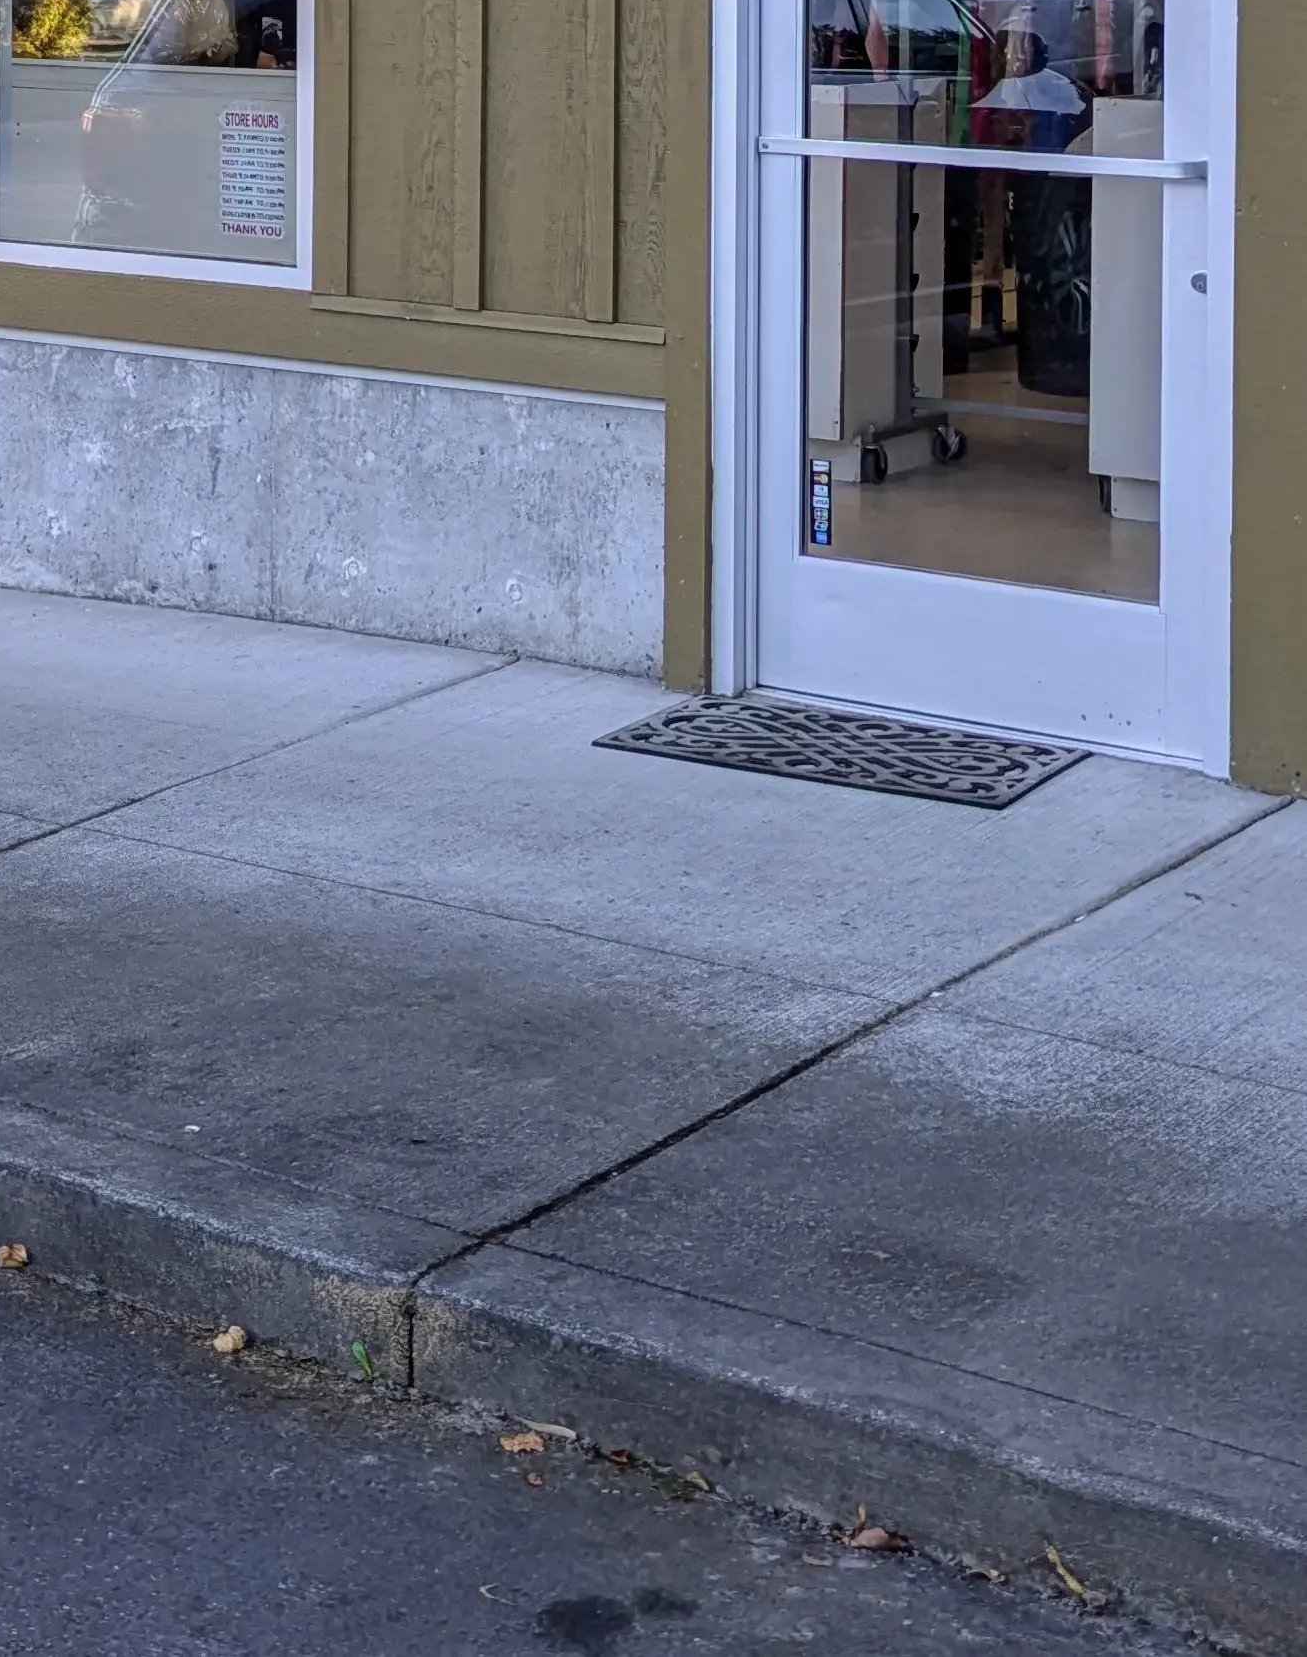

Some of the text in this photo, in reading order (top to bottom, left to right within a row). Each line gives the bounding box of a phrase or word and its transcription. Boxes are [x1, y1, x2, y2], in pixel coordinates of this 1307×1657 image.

[225, 112, 279, 129] STORE HOURS
[221, 222, 282, 237] THANK YOU
